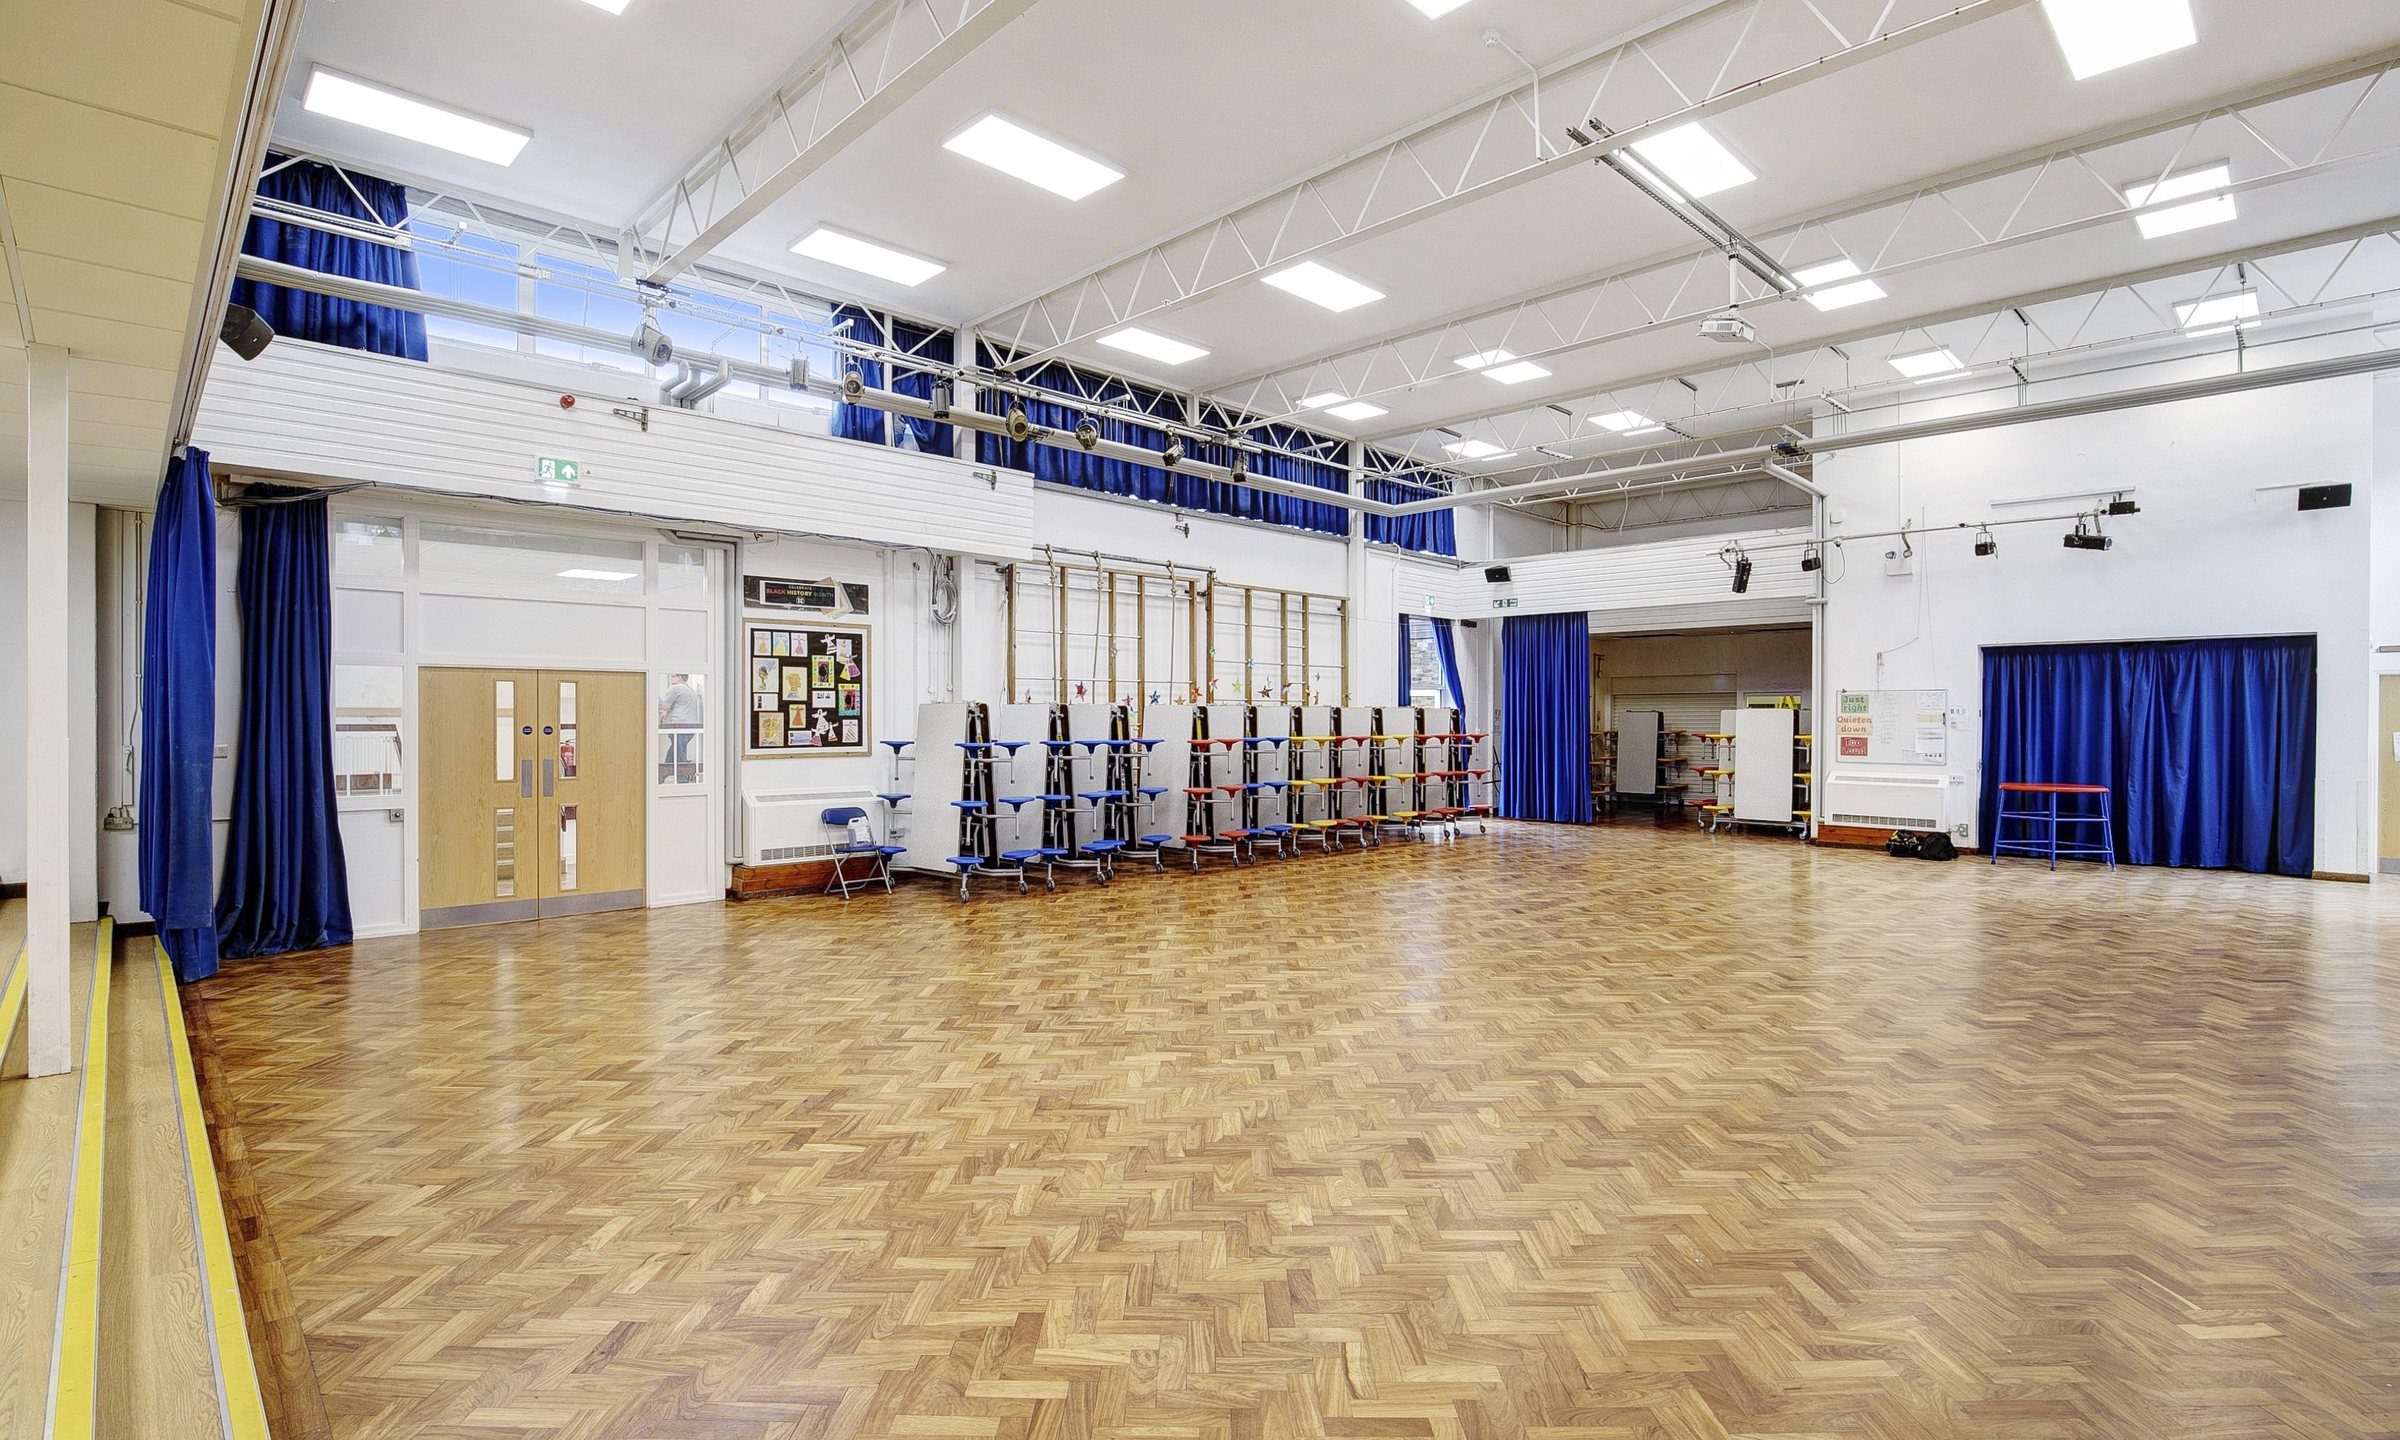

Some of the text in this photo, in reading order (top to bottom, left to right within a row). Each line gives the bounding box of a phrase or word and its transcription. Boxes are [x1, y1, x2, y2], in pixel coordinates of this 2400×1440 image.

[1843, 695, 1865, 703] Just
[1843, 704, 1867, 713] right
[1836, 715, 1872, 724] Quieten
[1840, 725, 1867, 733] down
[1845, 738, 1862, 746] Too
